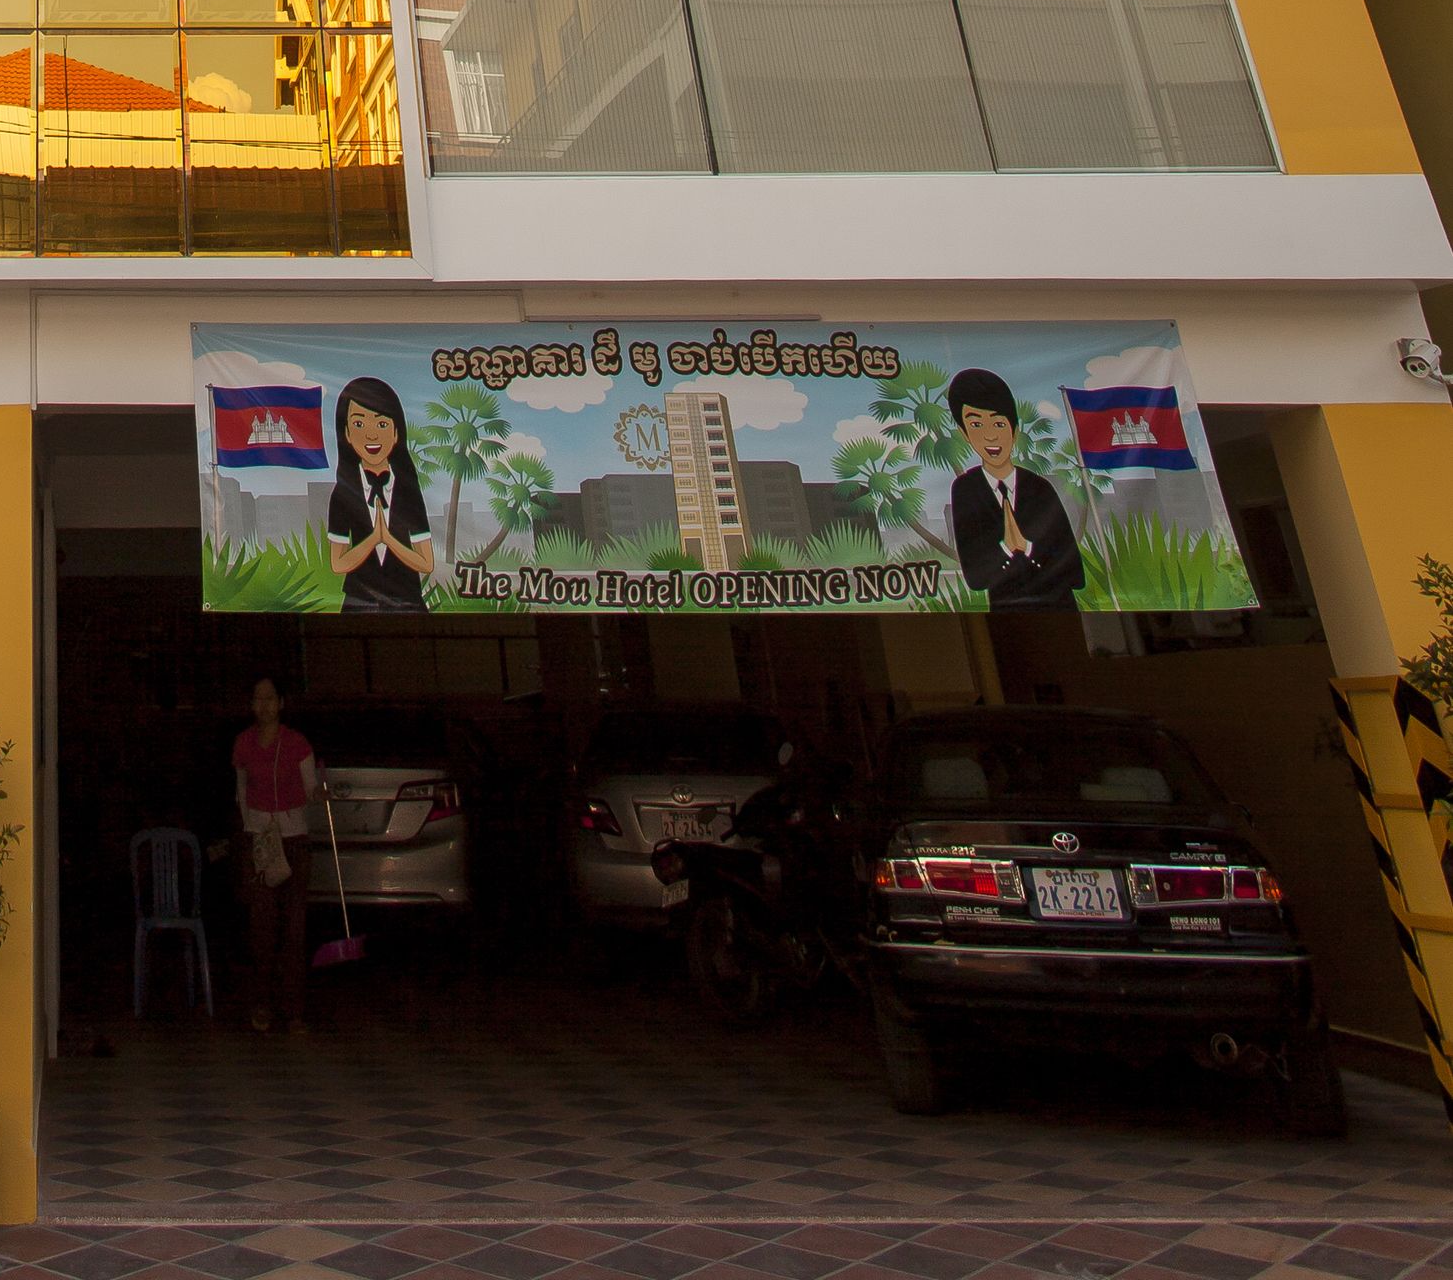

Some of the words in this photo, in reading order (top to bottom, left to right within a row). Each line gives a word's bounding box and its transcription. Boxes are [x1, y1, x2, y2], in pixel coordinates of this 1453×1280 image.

[456, 561, 512, 599] The
[521, 567, 590, 605] Mou
[596, 569, 684, 607] Hotel
[691, 569, 847, 607] OPENING
[854, 561, 942, 603] NOW
[1170, 852, 1213, 861] CAMRY
[1038, 886, 1119, 911] 2K-2212
